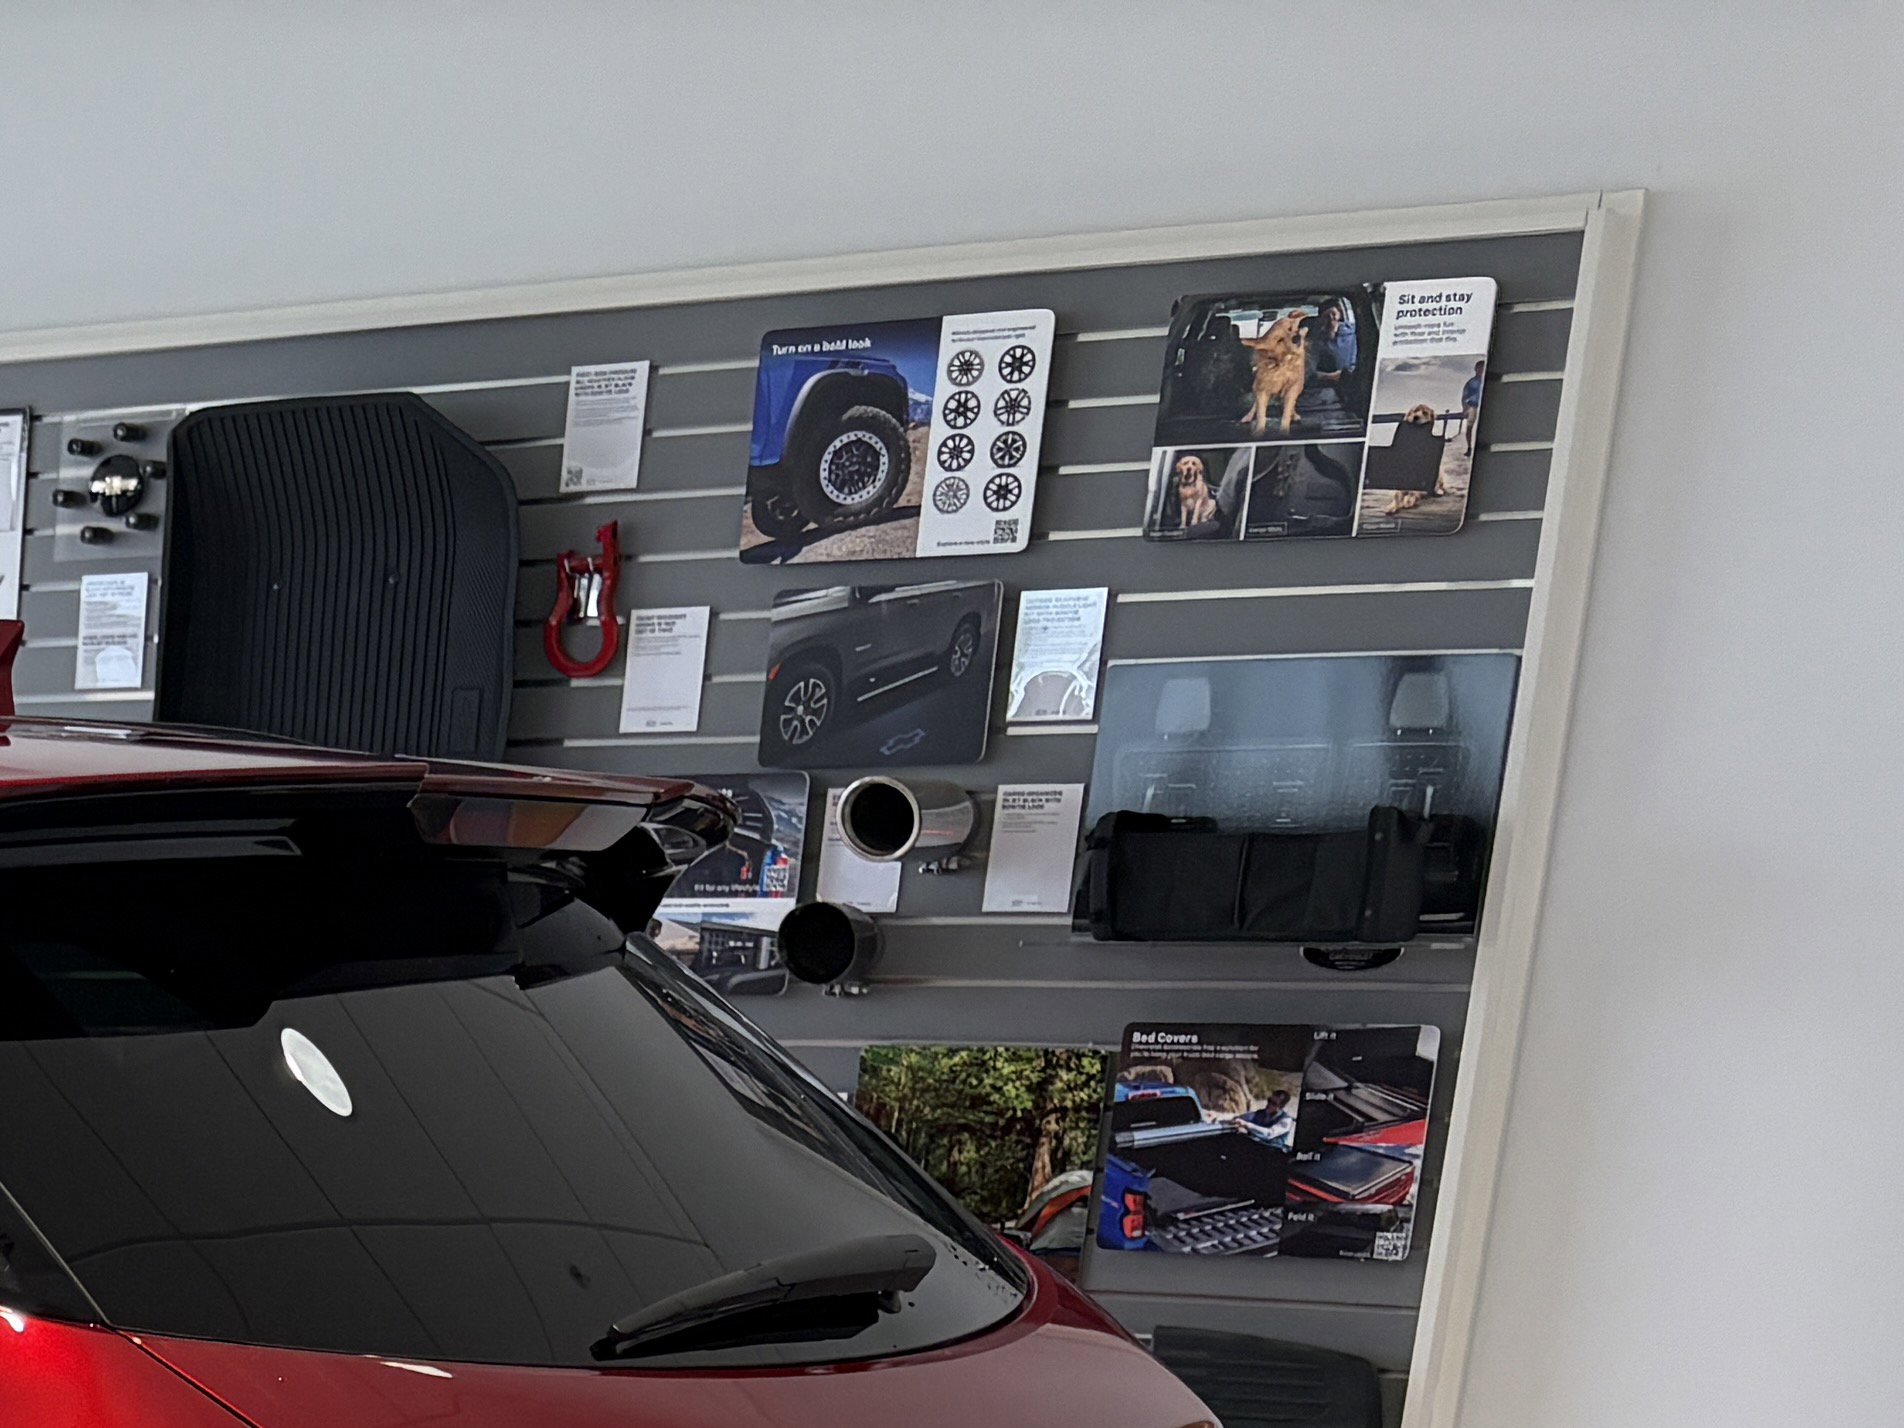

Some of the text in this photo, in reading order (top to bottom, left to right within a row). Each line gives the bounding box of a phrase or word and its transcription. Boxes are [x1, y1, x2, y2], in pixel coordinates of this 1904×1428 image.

[1398, 292, 1473, 305] Sit and stay
[1396, 305, 1463, 320] protection
[772, 337, 872, 356] Turn on a bold look
[716, 885, 730, 893] any
[1132, 1031, 1198, 1043] Bed Covers
[1313, 1032, 1329, 1040] Lift
[1306, 1092, 1327, 1100] Slide
[1288, 1213, 1306, 1221] Fold
